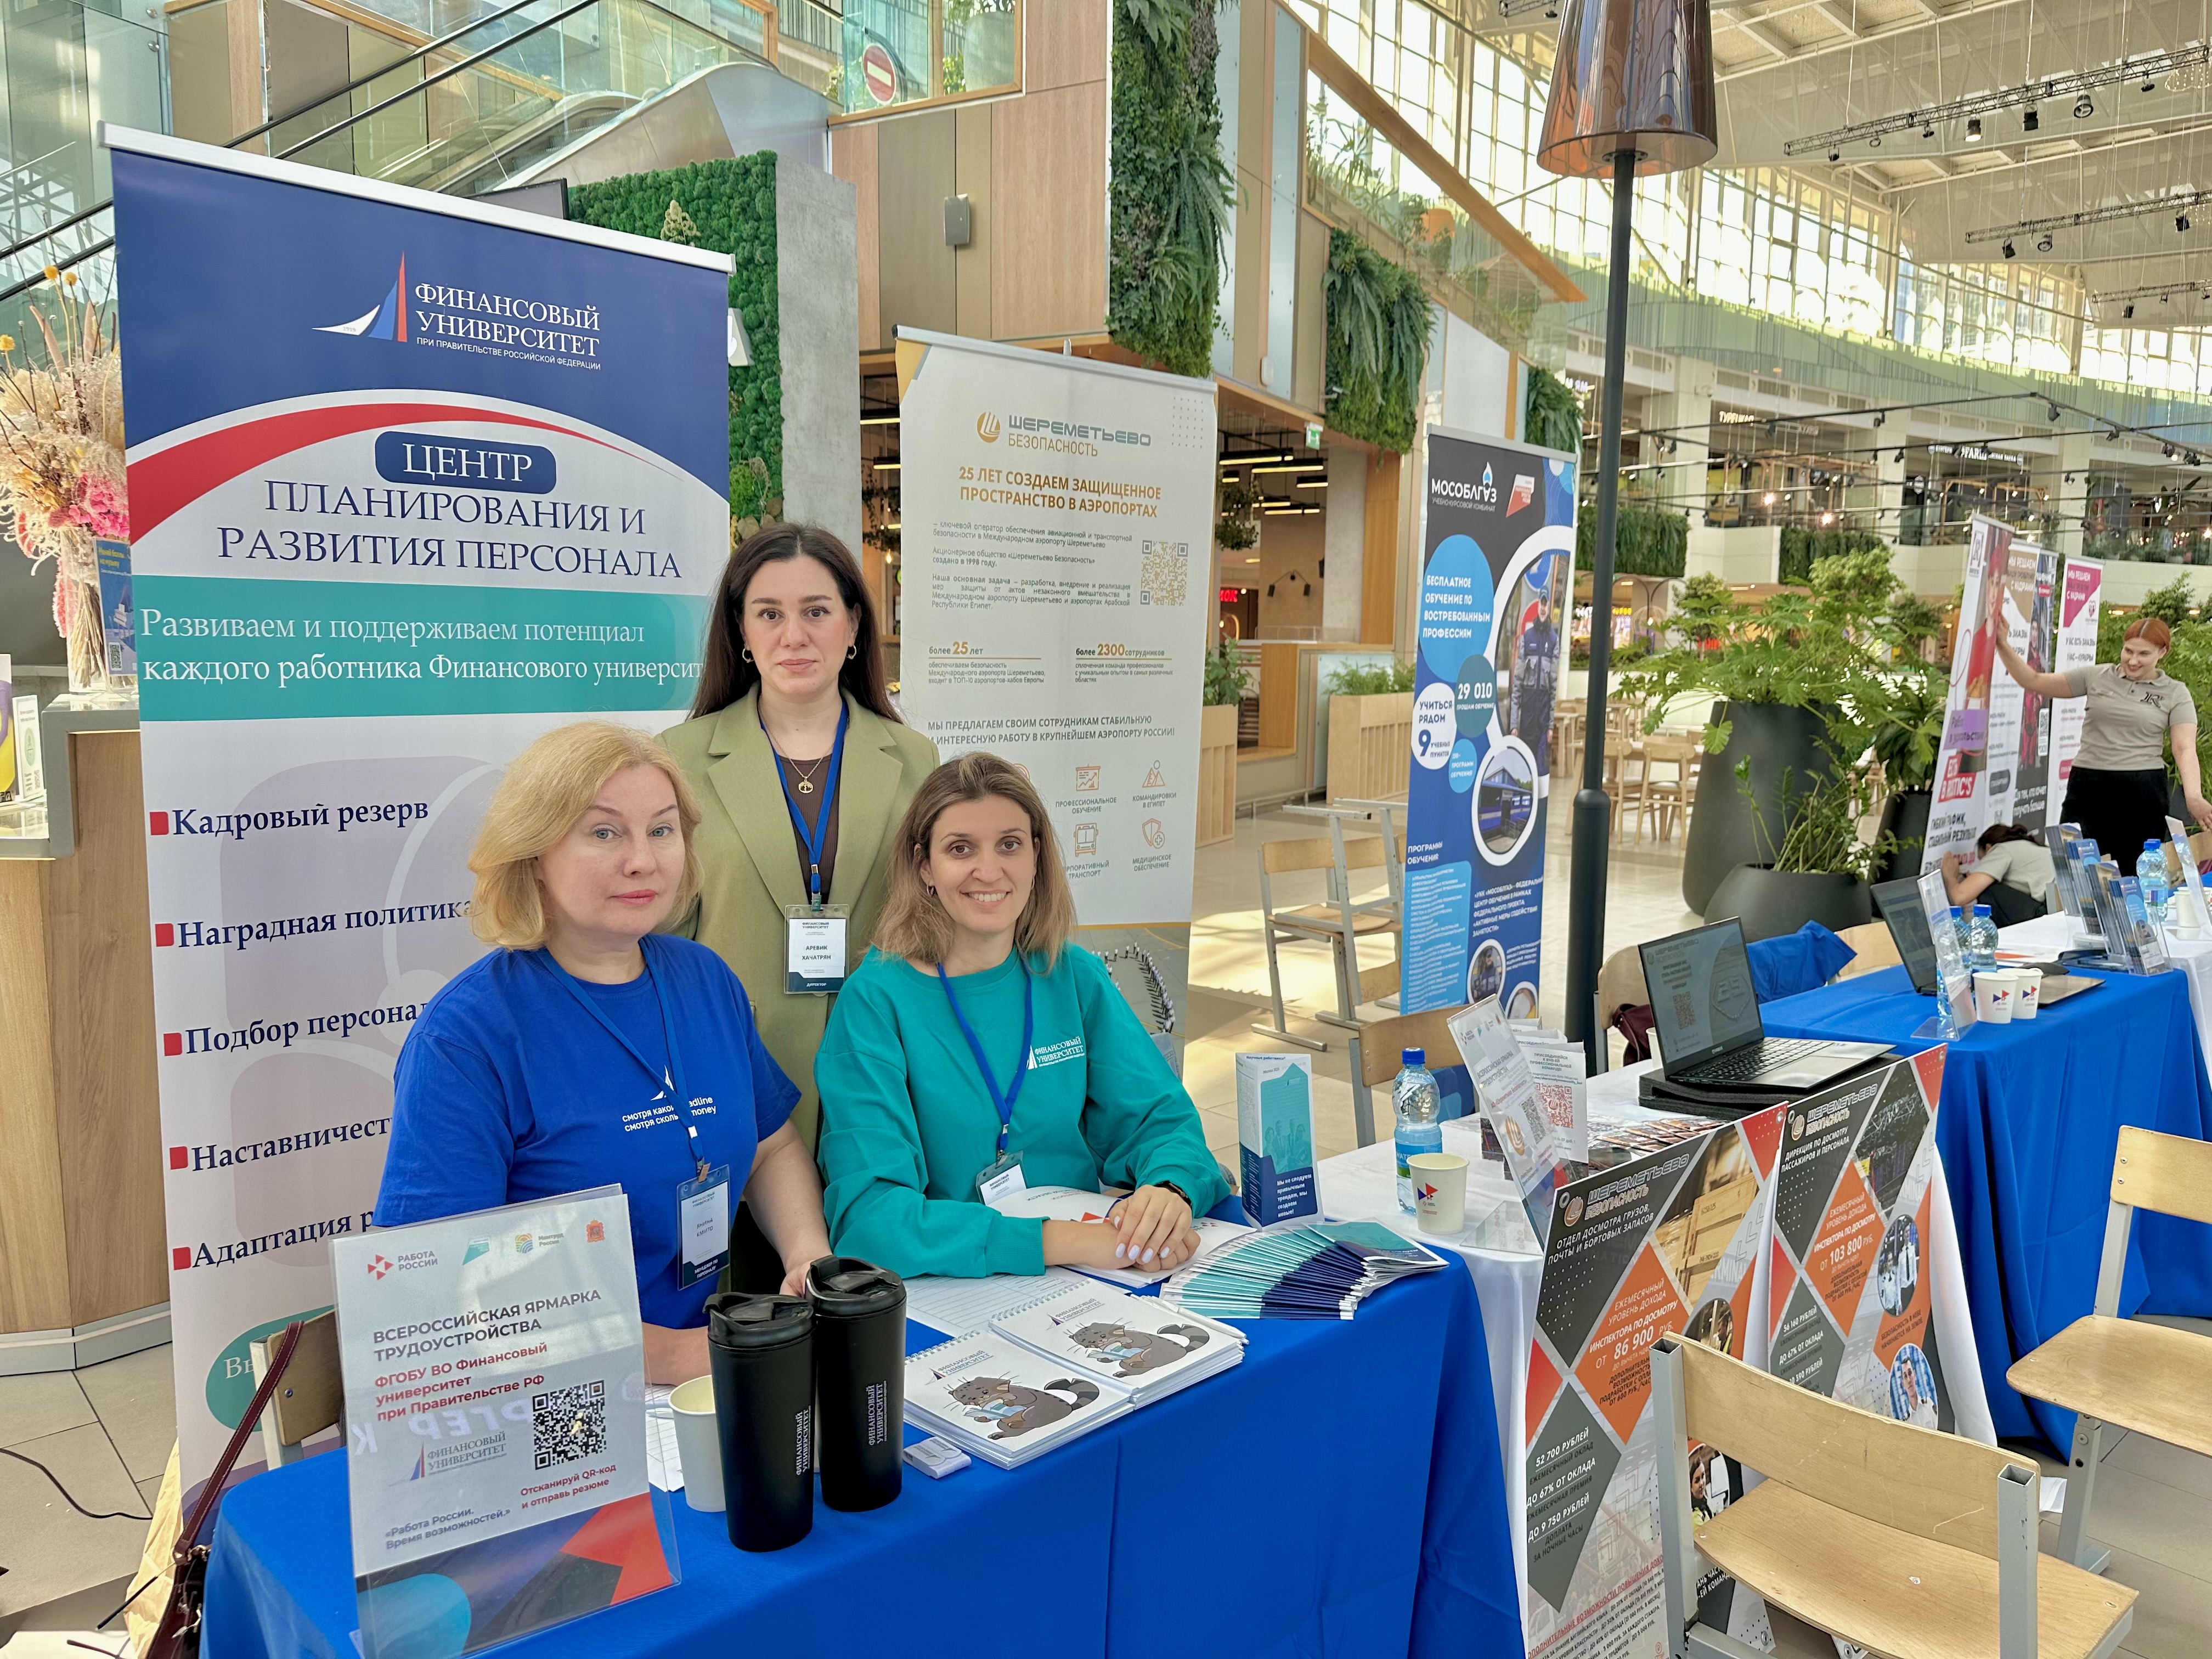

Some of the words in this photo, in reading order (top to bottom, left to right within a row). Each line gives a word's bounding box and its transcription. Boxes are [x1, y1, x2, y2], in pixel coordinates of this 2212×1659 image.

[415, 283, 600, 331] ФИНАНСОВЫЙ
[415, 311, 600, 357] УНИВЕРСИТЕТ
[417, 337, 435, 347] ПРИ
[436, 340, 502, 357] ПРАВИТЕЛЬСТВЕ
[504, 349, 555, 364] РОССИЙСКОЙ
[557, 357, 601, 370] ФЕДЕРАЦИИ
[1008, 433, 1098, 457] БЕЗОПАСНОСТЬ
[1009, 415, 1151, 447] ШЕРЕМЕТЬЕВО
[402, 443, 532, 482] ЦЕНТР
[959, 466, 974, 481] 25
[977, 468, 1002, 483] ЛЕТ
[1006, 472, 1069, 491] СОЗДАЕМ
[1073, 478, 1161, 500] ЗАЩИЩЕННОЕ
[1431, 478, 1497, 503] МОСОБЛГАЗ
[264, 480, 609, 533] ПЛАНИРОВАНИЯ
[620, 507, 646, 534] И
[960, 486, 1065, 510] ПРОСТРАНСТВО
[1069, 498, 1076, 510] В
[1079, 499, 1158, 518] АЭРОПОРТАХ
[217, 527, 445, 567] РАЗВИТИЯ
[455, 540, 682, 579] ПЕРСОНАЛА
[933, 546, 975, 556] Акционерное
[1008, 552, 1053, 561] «Шереметьево
[1426, 575, 1471, 588] БЕСПЛАТНОЕ
[1425, 593, 1463, 605] ОБУЧЕНИЕ
[1464, 595, 1472, 605] ПО
[140, 608, 296, 639] Развиваем
[304, 620, 322, 637] и
[329, 619, 517, 645] поддерживаем
[524, 623, 645, 644] потенциал
[1423, 628, 1471, 639] ПРОФЕССИЯМ
[1424, 612, 1491, 623] ВОСТРЕБОВАННЫМ
[952, 641, 968, 654] 25
[1097, 644, 1125, 656] 2300
[1125, 650, 1164, 658] сотрудников
[144, 658, 268, 685] каждого
[279, 651, 422, 689] работника
[429, 654, 588, 680] Финансового
[594, 661, 703, 685] университ
[1420, 701, 1452, 710] УЧИТЬСЯ
[1458, 683, 1470, 699] 29
[1474, 682, 1492, 699] 010
[928, 721, 943, 730] МЫ
[946, 720, 1003, 731] ПРЕДЛАГАЕМ
[1006, 719, 1036, 728] СВОИМ
[1039, 717, 1098, 728] СОТРУДНИКАМ
[1101, 715, 1152, 725] СТАБИЛЬНУЮ
[1419, 714, 1446, 724] РЯДОМ
[936, 734, 996, 745] ИНТЕРЕСНУЮ
[998, 733, 1030, 742] РАБОТУ
[1040, 730, 1096, 741] КРУПНЕЙШЕМ
[1098, 729, 1143, 739] АЭРОПОРТУ
[1144, 727, 1175, 737] РОССИИ!
[1419, 729, 1431, 757] 9
[1056, 797, 1117, 808] ПРОФЕССИОНАЛЬНОЕ
[1072, 805, 1102, 814] ОБУЧЕНИЕ
[1132, 792, 1177, 802] КОМАНДИРОВКИ
[1147, 800, 1165, 808] ЕГИПЕТ
[172, 803, 329, 840] Кадровый
[337, 802, 429, 832] резерв
[1067, 860, 1109, 872] РПОРАТИВНЫЙ
[1069, 870, 1101, 879] ТРАНСПОРТ
[1132, 854, 1172, 865] МЕДИЦИНСКОЕ
[1134, 861, 1169, 872] ОБЕСПЕЧЕНИЕ
[177, 912, 337, 950] Наградная
[186, 1019, 300, 1054] Подбор
[1035, 1036, 1081, 1054] ФИНАНСОВЫЙ
[1036, 1045, 1084, 1063] УНИВЕРСИТЕТ
[622, 1109, 652, 1122] смотря
[689, 1097, 713, 1107] adline
[1807, 1084, 1878, 1122] ШЕРЕМЕТЬЕВО
[624, 1119, 655, 1131] смотря
[656, 1114, 679, 1124] сколь
[1805, 1108, 1850, 1136] БЕЗОПАСНОСТЬ
[191, 1116, 392, 1171] Наставничест
[1781, 1151, 1815, 1173] ПАССАЖИРОВ
[1821, 1136, 1849, 1153] ПЕРСОНАЛА
[1785, 1143, 1812, 1162] ДИРЕКЦИЯ
[1813, 1139, 1821, 1148] ПО
[1821, 1126, 1848, 1146] ДОСМОТРУ
[1588, 1153, 1689, 1204] ШЕРЕМЕТЬЕВО
[1584, 1184, 1649, 1220] БЕЗОПАСНОСТЬ
[192, 1211, 352, 1269] Адаптация
[1548, 1248, 1573, 1265] ПОЧТЫ
[1576, 1244, 1582, 1253] И
[1584, 1227, 1622, 1250] БОРТОВЫХ
[1623, 1212, 1654, 1232] ЗАПАСОВ
[1556, 1232, 1581, 1249] ОТДЕЛ
[1582, 1216, 1621, 1239] ДОСМОТРА
[1623, 1204, 1650, 1222] ГРУЗОВ,
[398, 1250, 435, 1263] РАБОТА
[398, 1257, 438, 1272] РОССИИ
[1830, 1245, 1844, 1265] 103
[1847, 1235, 1862, 1255] 800
[1609, 1306, 1639, 1326] УРОВЕНЬ
[1639, 1290, 1666, 1312] ДОХОДА
[1615, 1277, 1664, 1311] ЕЖЕМЕСЯЧНЫЙ
[373, 1304, 521, 1344] ВСЕРОССИЙСКАЯ
[525, 1289, 601, 1314] ЯРМАРКА
[1590, 1323, 1632, 1353] ИНСПЕКТОРА
[1633, 1318, 1643, 1330] ПО
[1643, 1300, 1678, 1327] ДОСМОТРУ
[374, 1318, 542, 1362] ТРУДОУСТРОЙСТВА
[1596, 1355, 1607, 1368] ОТ
[1614, 1338, 1629, 1359] 86
[1632, 1325, 1654, 1350] 900
[1659, 1321, 1673, 1336] РУБ.
[375, 1367, 427, 1388] ФГОБУ
[431, 1362, 452, 1376] ВО
[455, 1342, 548, 1372] Финансовый
[376, 1375, 472, 1408] университет
[377, 1407, 406, 1423] при
[410, 1380, 520, 1415] Правительстве
[523, 1374, 545, 1387] РФ
[866, 1384, 876, 1446] ФИНАНСОВЫЙ
[427, 1431, 506, 1460] ФИНАНСОВЫЙ
[428, 1443, 507, 1471] УНИВЕРСИТЕТ
[1536, 1455, 1545, 1467] 52
[1547, 1446, 1560, 1464] 700
[1562, 1426, 1589, 1452] РУБЛЕЙ
[520, 1472, 580, 1497] Отсканируй
[582, 1464, 617, 1482] QR-код
[531, 1491, 571, 1508] отправь
[572, 1478, 610, 1498] резюме
[1526, 1493, 1537, 1510] ДО
[1539, 1482, 1554, 1499] 67%
[1556, 1475, 1566, 1488] ОТ
[1567, 1457, 1596, 1481] ОКЛАДА
[385, 1520, 430, 1538] «Работа
[432, 1508, 474, 1526] России.
[386, 1533, 422, 1550] Время
[425, 1508, 511, 1539] возможностей.»
[1528, 1527, 1539, 1544] ДО
[1542, 1522, 1545, 1532] 9
[1548, 1513, 1561, 1530] 750
[1563, 1492, 1589, 1518] РУБЛЕЙ
